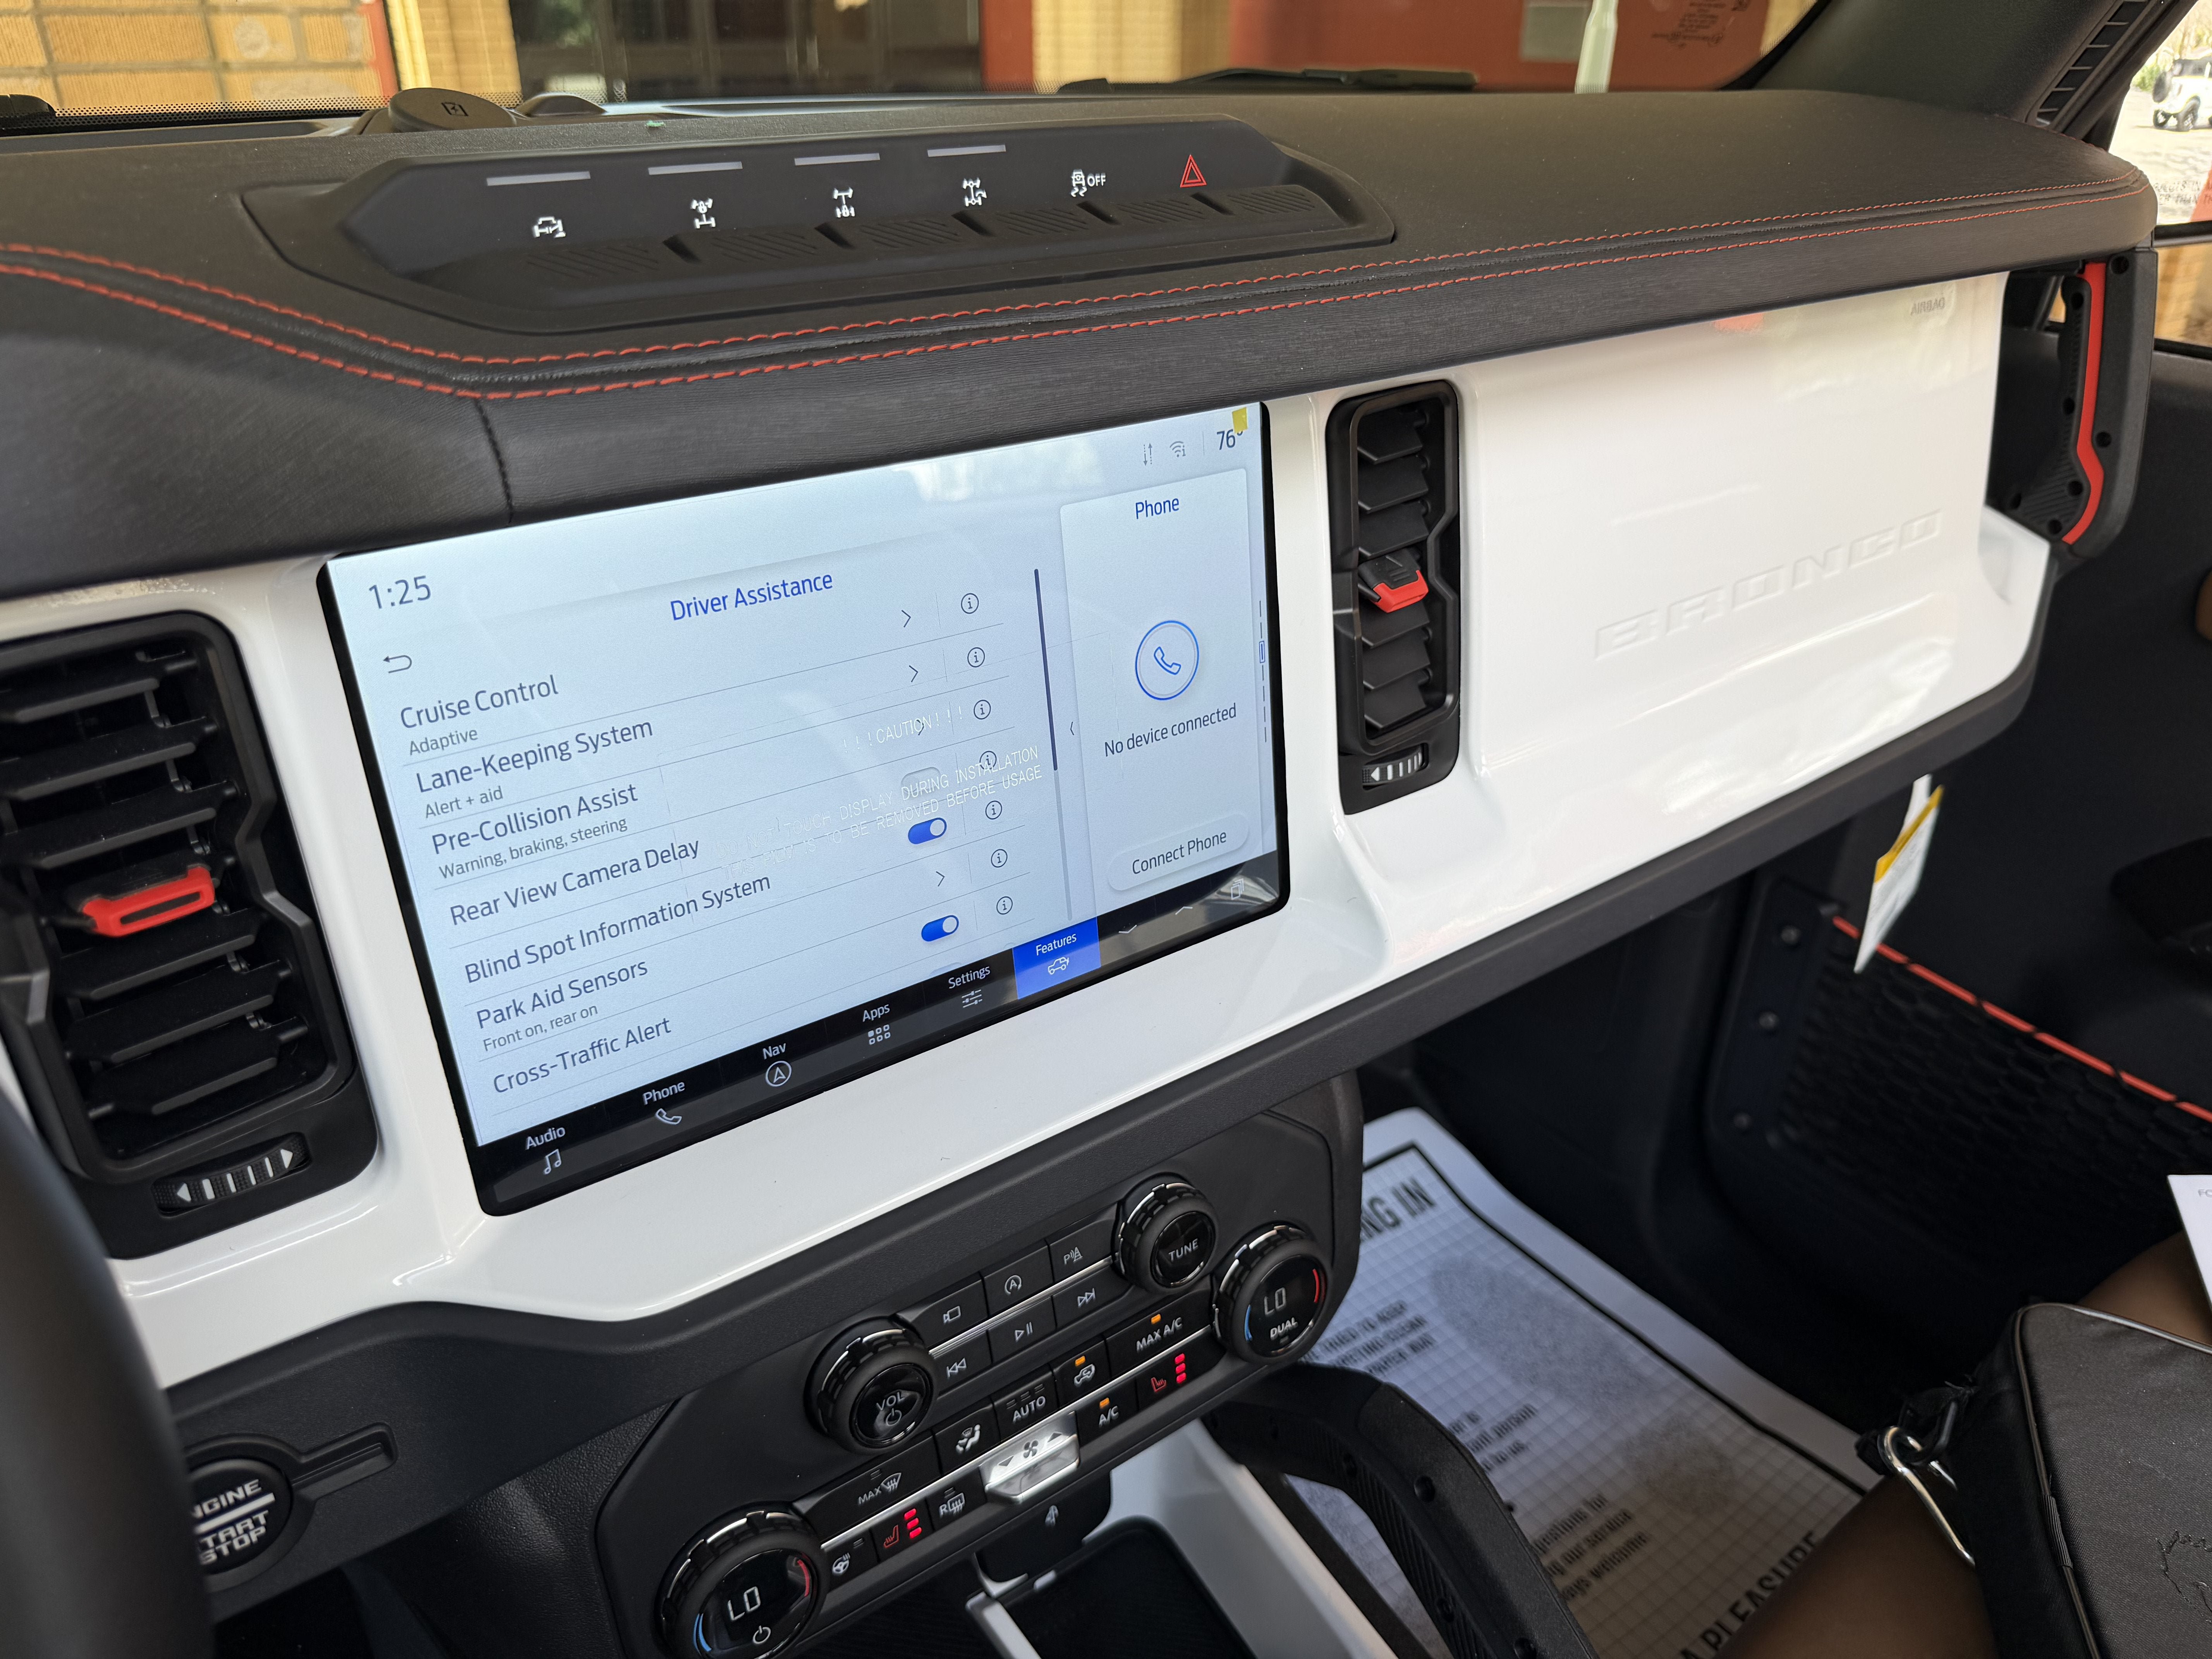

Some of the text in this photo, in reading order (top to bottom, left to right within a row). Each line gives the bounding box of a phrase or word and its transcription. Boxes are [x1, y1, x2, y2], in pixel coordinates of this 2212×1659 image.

[1087, 174, 1106, 187] OFF
[1135, 498, 1180, 519] Phone
[368, 575, 432, 610] 1:25
[670, 573, 833, 620] Driver Assistance
[1595, 508, 1941, 662] BRONCO
[401, 675, 559, 728] Cruise Control
[409, 727, 479, 756] Adaptive
[1105, 702, 1237, 757] No device connected
[417, 718, 653, 793] Lane-Keeping System
[425, 786, 503, 819] Alert + aid
[746, 828, 775, 850] NOT
[783, 811, 831, 836] TOUCH
[840, 790, 893, 820] DISPLAY
[901, 774, 949, 801] DURING
[955, 745, 1038, 784] INSTALLATION
[803, 838, 817, 854] IS
[824, 830, 842, 847] TO
[850, 820, 869, 839] BE
[876, 799, 939, 830] REMOVED
[946, 780, 996, 807] BEFORE
[1002, 764, 1042, 790] USAGE
[432, 783, 639, 855] Pre-Collision Assist
[440, 816, 628, 879] Warning, braking, steering
[1132, 831, 1227, 874] Connect Phone
[450, 839, 700, 926] Rear View Camera Delay
[466, 875, 771, 983] Blind Spot Information System
[1036, 933, 1077, 956] Features
[477, 959, 648, 1029] Park Aid Sensors
[948, 965, 991, 989] Settings
[483, 1006, 598, 1052] Front on, rear on
[862, 1004, 891, 1024] Apps
[493, 1017, 672, 1094] Cross-Traffic Alert
[763, 1042, 787, 1060] Nav
[642, 1080, 686, 1106] Phone
[526, 1125, 566, 1150] Audio
[1391, 1176, 1437, 1218] IN
[1168, 1238, 1199, 1262] TUNE
[1264, 1287, 1286, 1316] LO
[1136, 1317, 1183, 1352] MAX A/C
[1270, 1317, 1298, 1341] DUAL
[876, 1391, 905, 1411] VOL
[1012, 1395, 1046, 1423] AUTO
[1098, 1405, 1119, 1427] A/C
[857, 1485, 882, 1506] MAX
[199, 1525, 266, 1566] STOP
[200, 1510, 269, 1549] TART
[727, 1586, 761, 1621] LO
